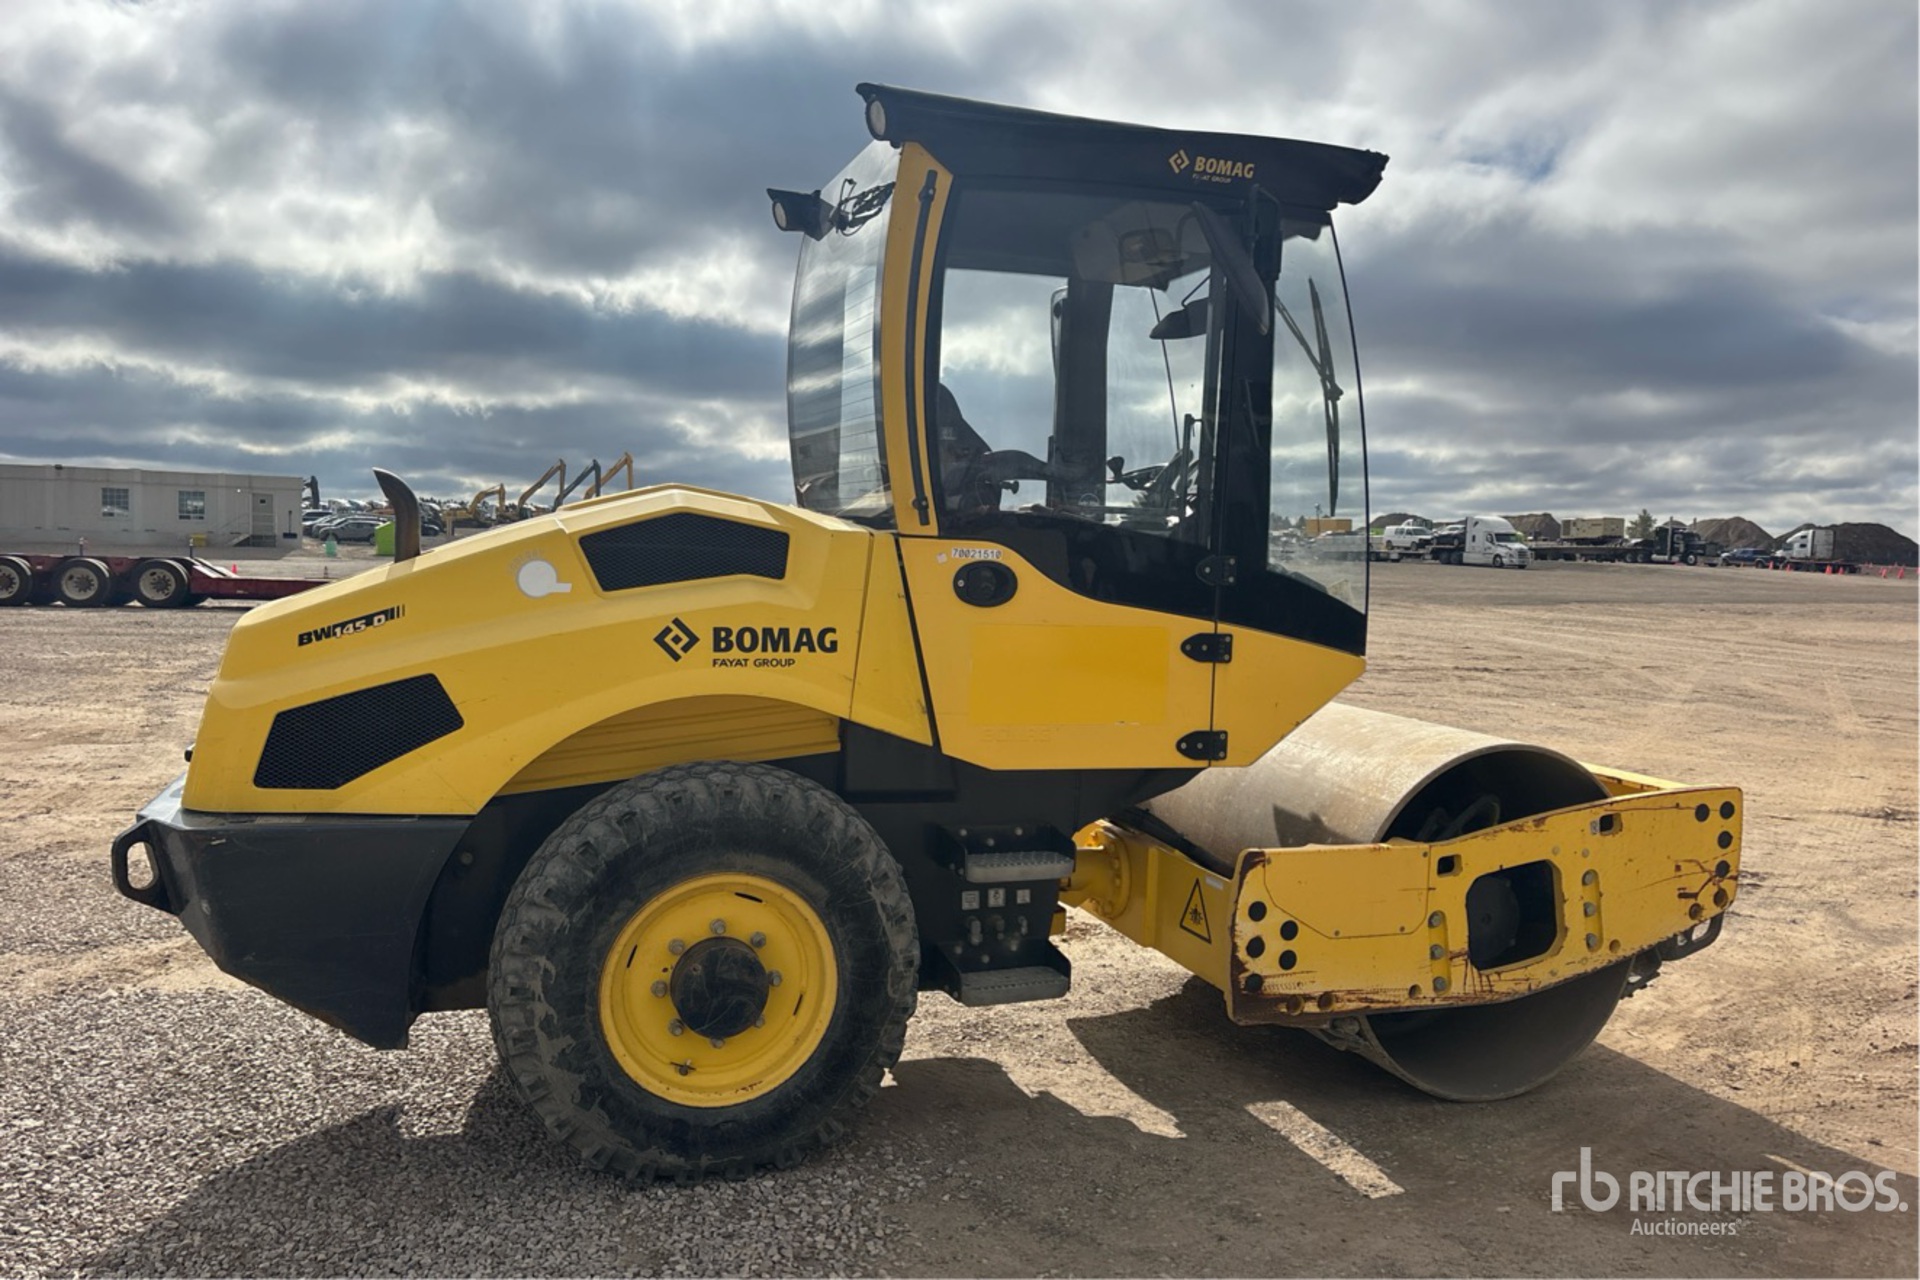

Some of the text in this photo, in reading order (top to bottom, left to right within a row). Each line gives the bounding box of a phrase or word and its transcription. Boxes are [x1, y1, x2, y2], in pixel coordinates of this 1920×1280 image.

[1194, 156, 1254, 178] BOMAG
[712, 626, 838, 653] BOMAG
[712, 658, 796, 667] FAYAT GROUP
